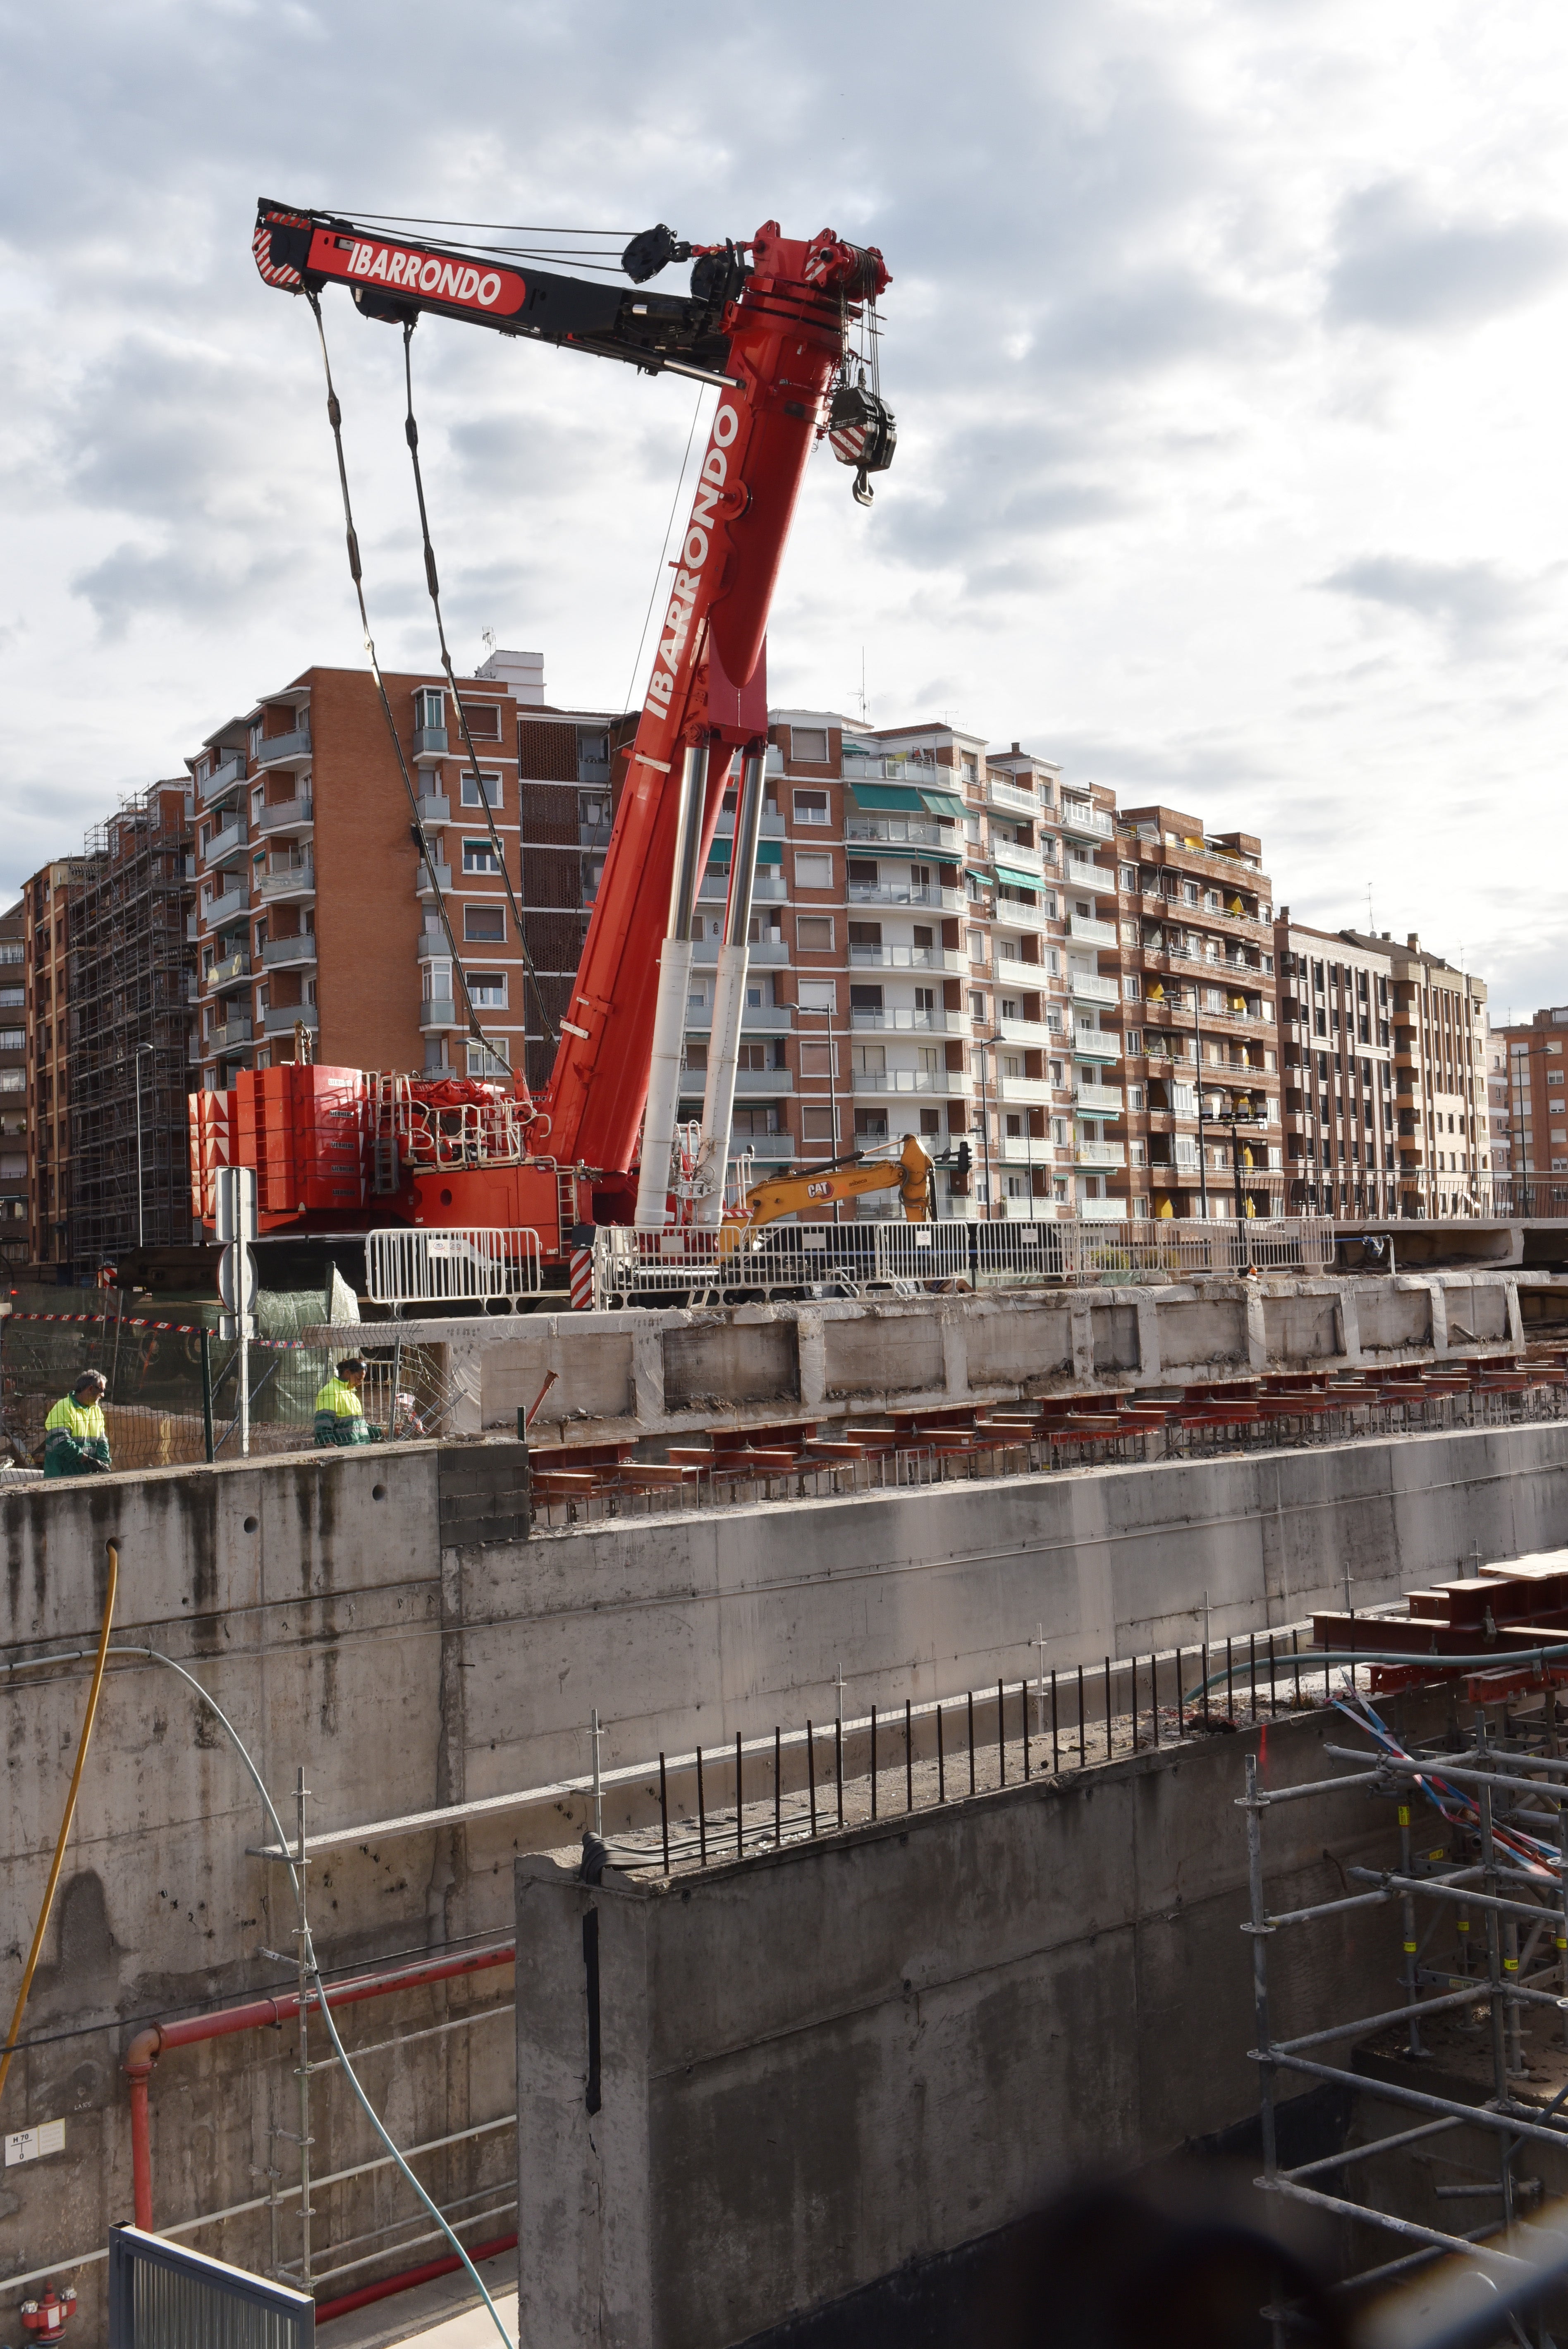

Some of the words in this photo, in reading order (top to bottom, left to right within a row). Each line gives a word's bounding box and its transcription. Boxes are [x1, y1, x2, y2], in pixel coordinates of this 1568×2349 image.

[347, 243, 501, 305] IBARRONDO
[645, 404, 739, 720] IBARRONDO
[808, 1182, 827, 1198] CAT
[849, 1179, 868, 1187] asbeca
[74, 2102, 91, 2110] LA105
